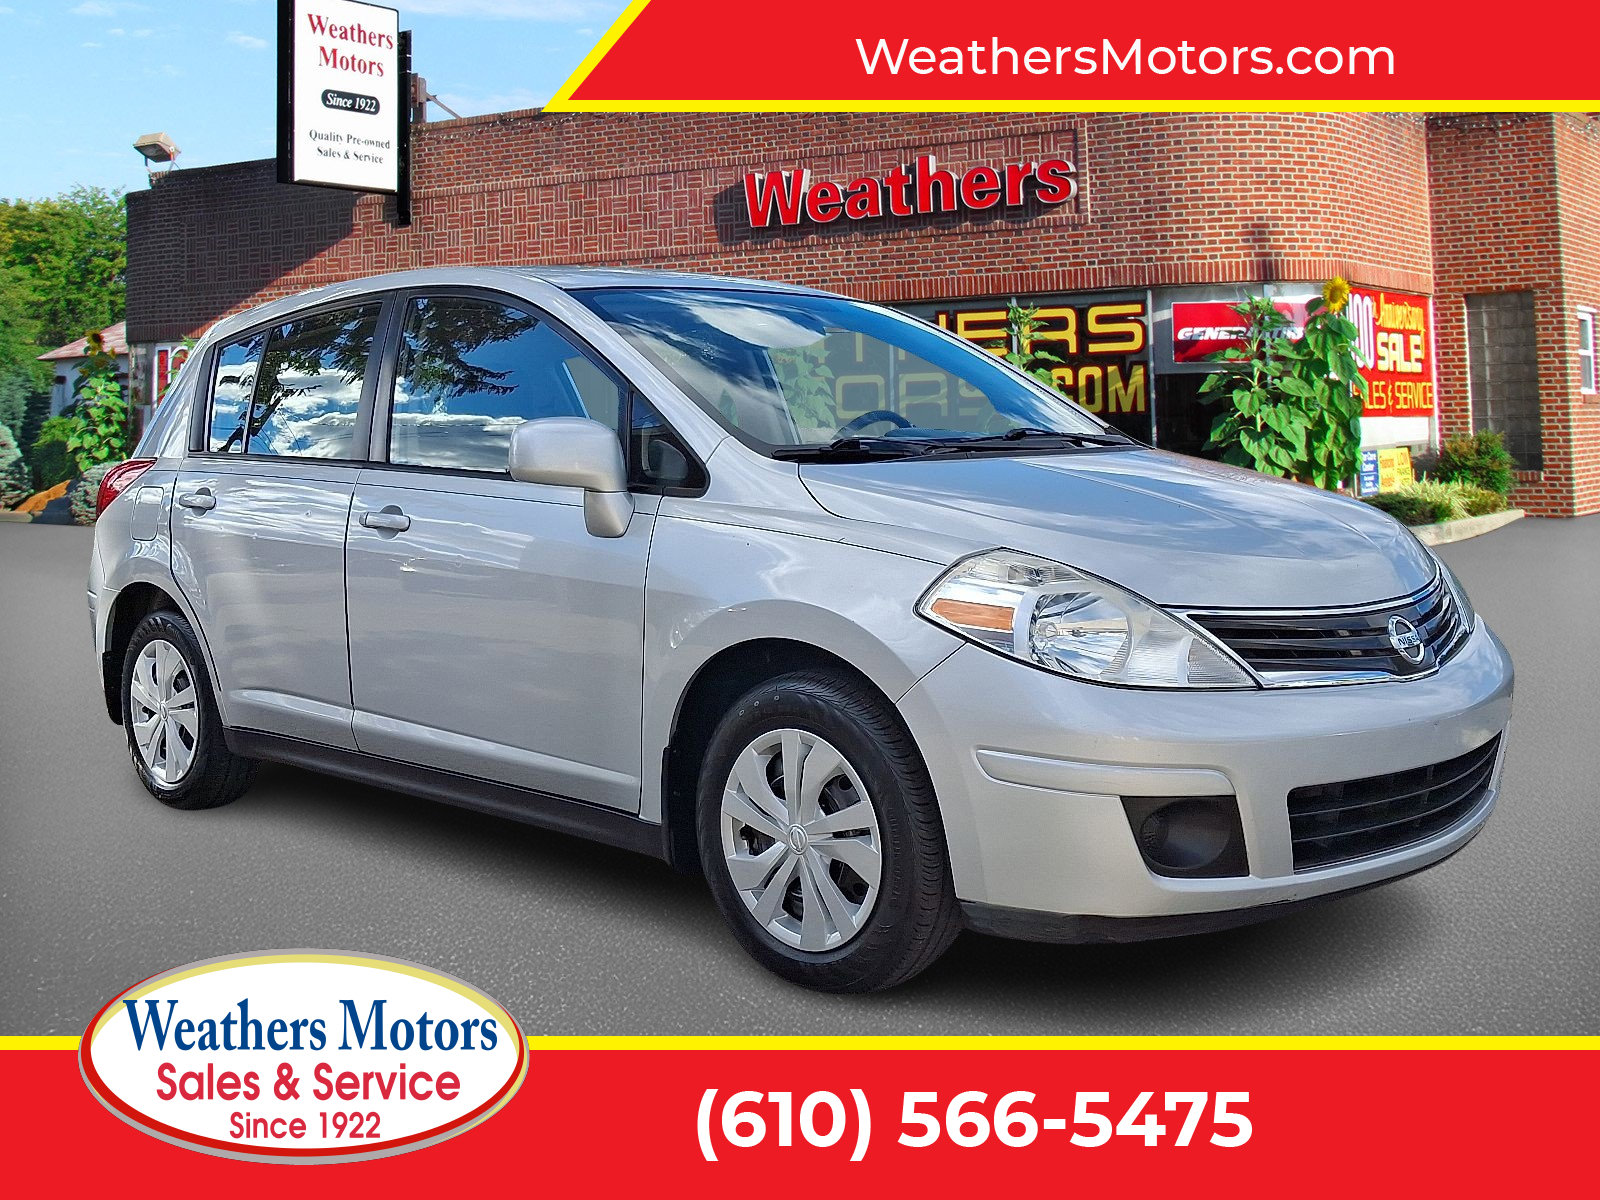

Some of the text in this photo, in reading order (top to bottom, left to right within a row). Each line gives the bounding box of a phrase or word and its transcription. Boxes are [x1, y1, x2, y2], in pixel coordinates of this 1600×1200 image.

[307, 13, 394, 50] Weathers
[318, 45, 385, 78] Motors
[326, 92, 377, 112] Since 1922
[309, 129, 390, 150] Quality Pre-owned
[317, 146, 384, 164] Sales & Service
[742, 154, 1078, 229] Weathers
[1376, 331, 1423, 374] SALE
[1394, 381, 1433, 410] SERVICE
